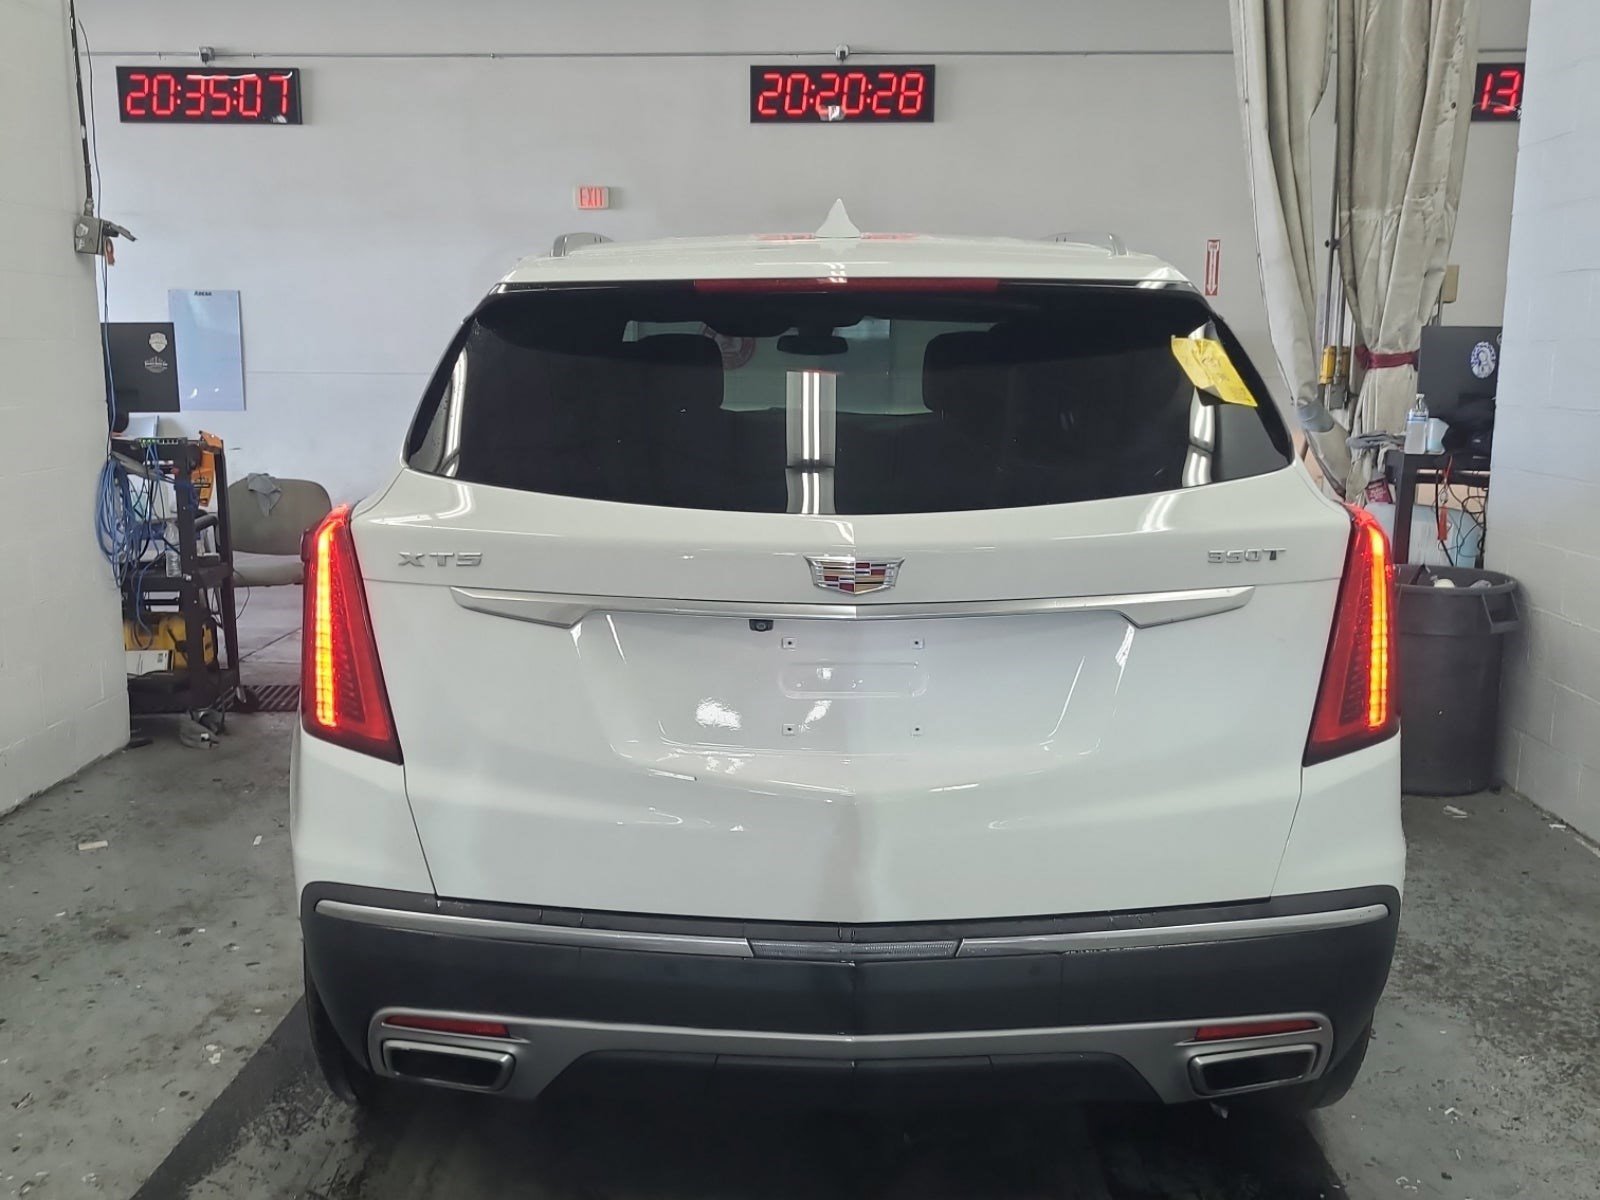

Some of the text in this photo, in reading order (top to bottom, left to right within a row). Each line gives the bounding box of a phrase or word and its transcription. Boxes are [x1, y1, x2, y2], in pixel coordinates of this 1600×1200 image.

[125, 73, 289, 117] 20:35:07
[757, 72, 925, 115] 20:20:28
[1479, 70, 1521, 113] 13
[579, 186, 605, 207] EXIT
[398, 551, 483, 568] XT5
